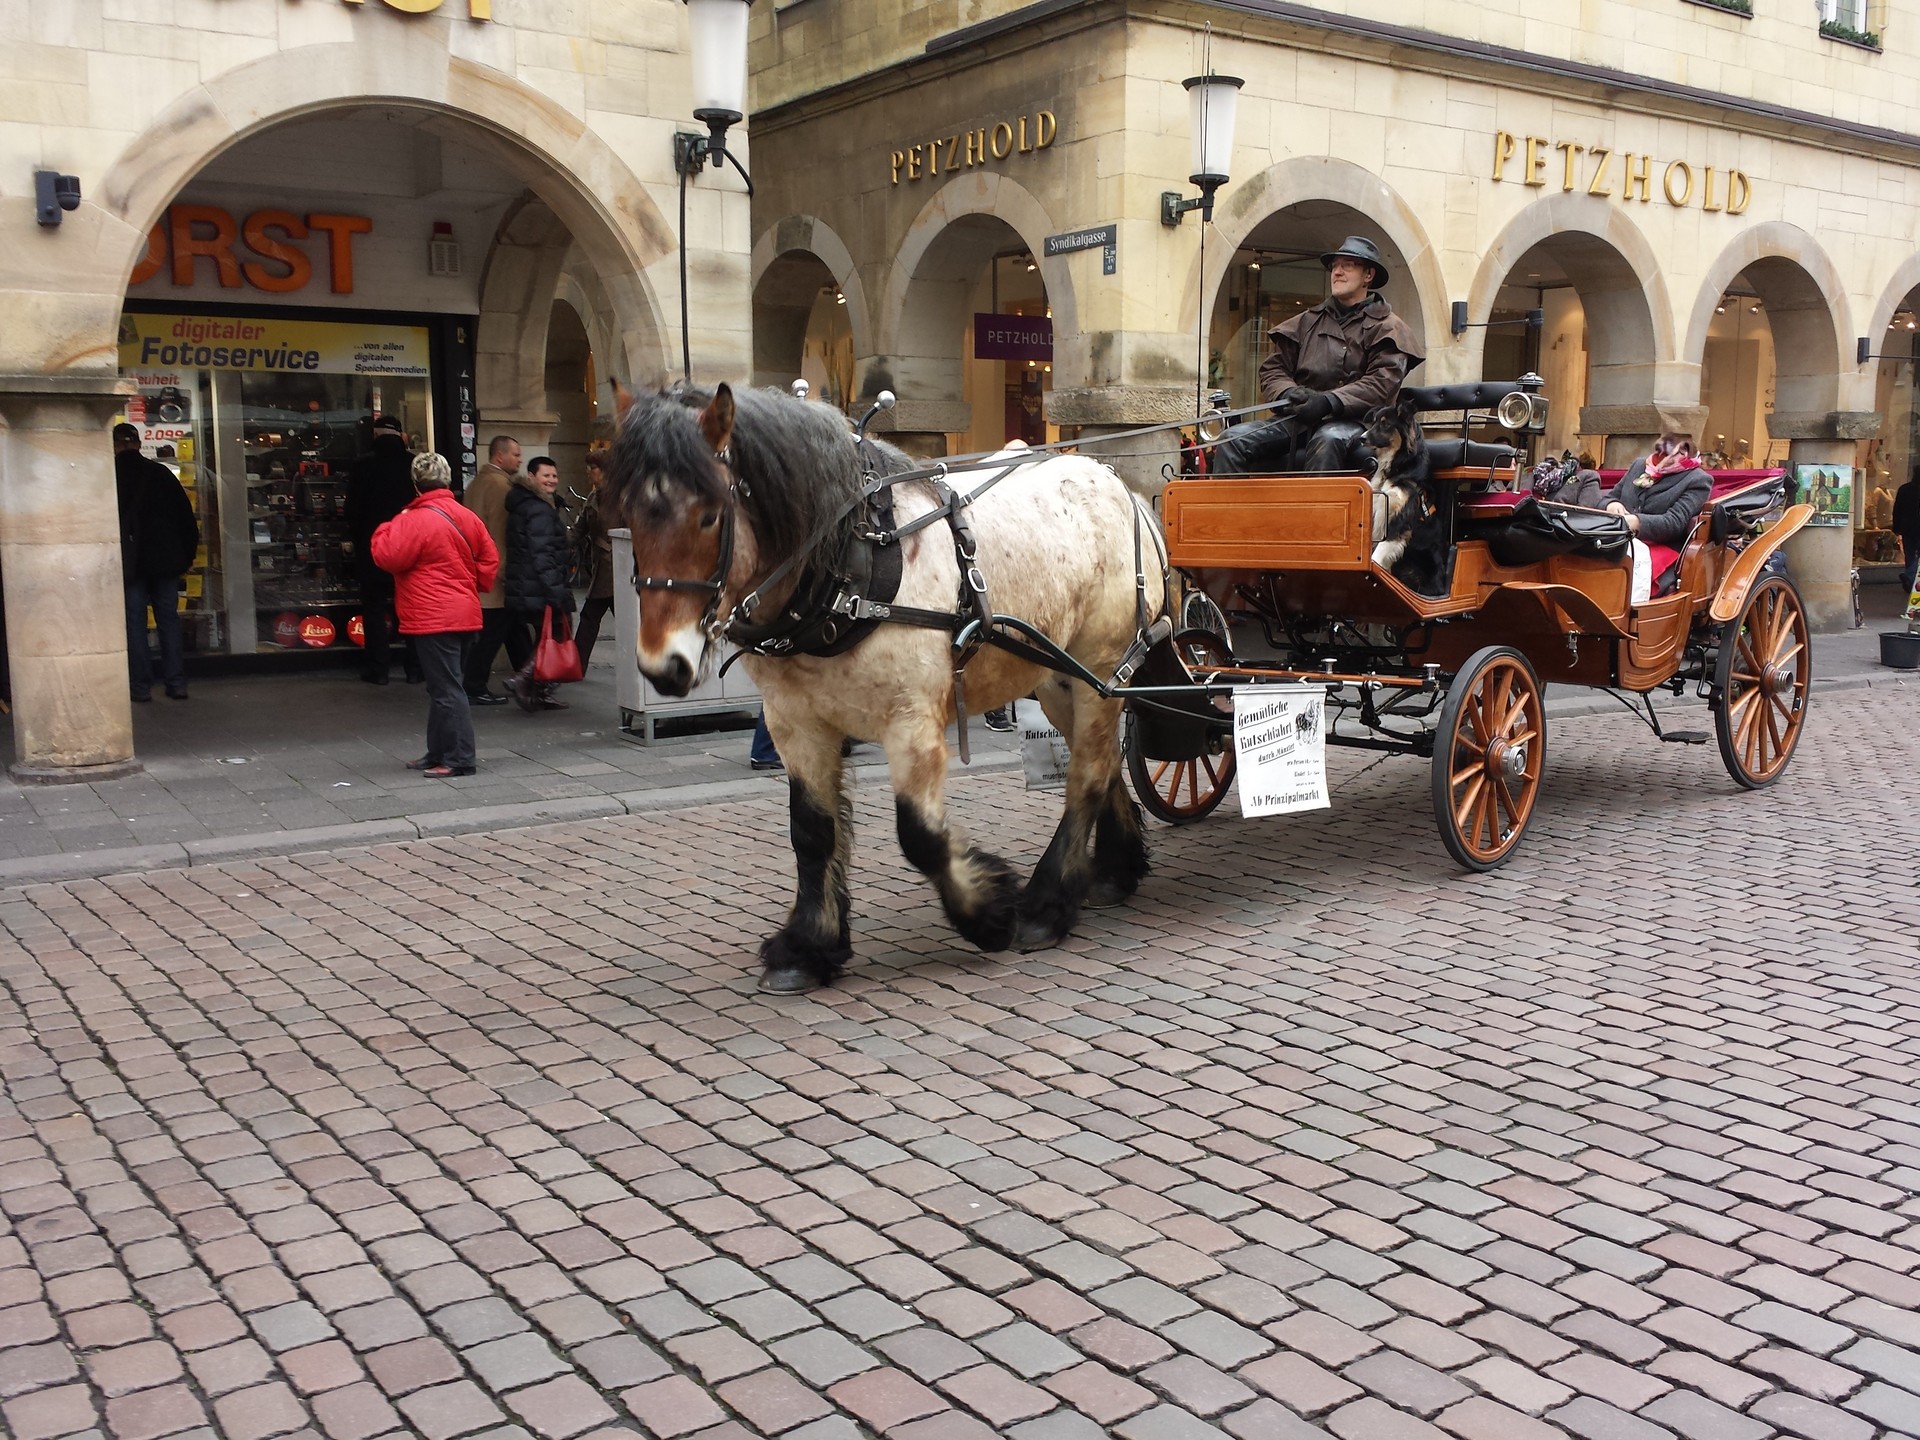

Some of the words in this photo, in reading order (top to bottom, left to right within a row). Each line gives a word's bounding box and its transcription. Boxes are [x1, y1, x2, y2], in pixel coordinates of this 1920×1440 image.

[891, 110, 1057, 184] PETZHOLD
[1492, 129, 1752, 215] PETZHOLD
[1050, 231, 1107, 252] Syndikalgasse
[172, 318, 265, 343] digitaler
[988, 330, 1053, 345] PETZHOLD
[141, 336, 320, 369] Fotoservice
[354, 352, 394, 362] digitalen
[383, 342, 404, 351] allen
[355, 363, 427, 374] Speichermedien
[302, 623, 333, 637] Leica
[1238, 700, 1289, 728] Gemütliche
[1240, 722, 1292, 750] Kutschfahrt
[1250, 795, 1262, 807] Ab
[1265, 789, 1319, 806] Prinzipalmarkt
